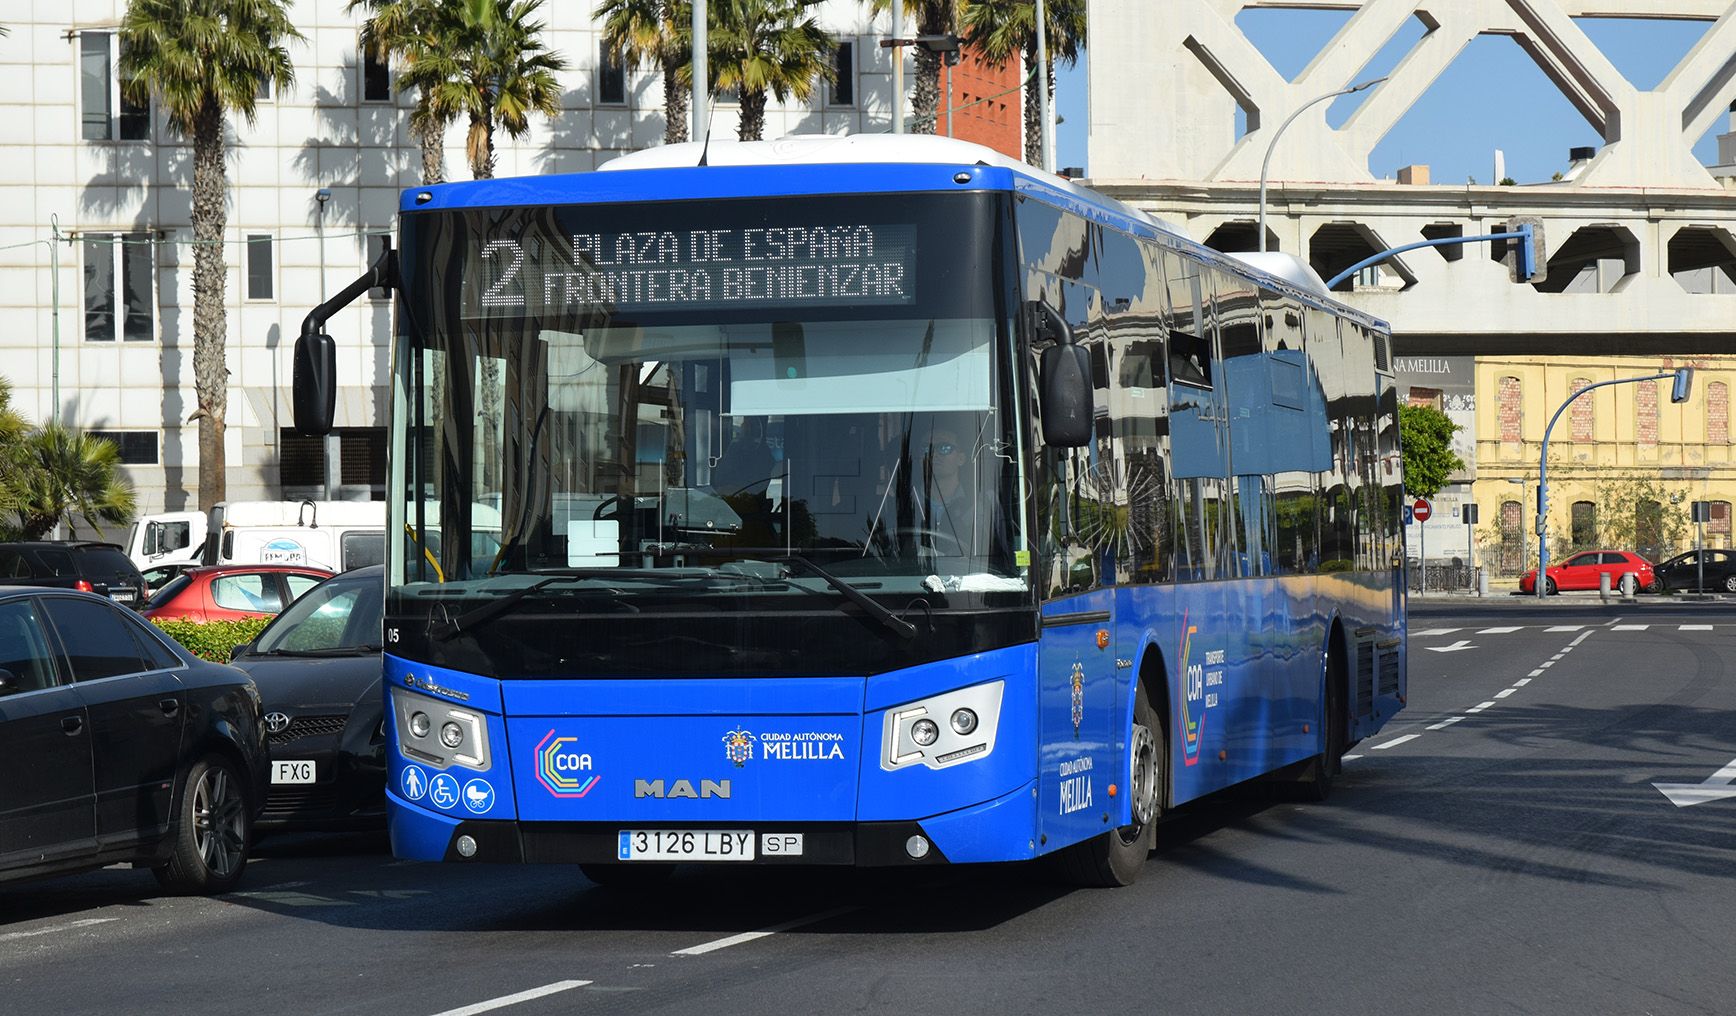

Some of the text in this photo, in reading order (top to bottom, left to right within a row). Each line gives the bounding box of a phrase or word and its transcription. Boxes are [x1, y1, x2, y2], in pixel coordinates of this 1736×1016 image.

[573, 225, 873, 265] PLAZA DE ESPAÑA
[481, 239, 524, 306] 2
[544, 263, 904, 304] FRONTERA BENIENZAR
[1407, 359, 1450, 374] MELILLA
[388, 628, 399, 643] 05
[1187, 664, 1203, 701] COA
[760, 732, 843, 741] CIUDAD AUTÓNOMA
[763, 742, 845, 759] MELILLA
[556, 753, 592, 770] COA
[280, 763, 310, 780] FXG
[634, 779, 731, 799] MAN
[1060, 775, 1093, 816] MELILLA
[635, 832, 695, 854] 3126
[704, 833, 749, 856] LBY
[767, 837, 798, 852] SP
